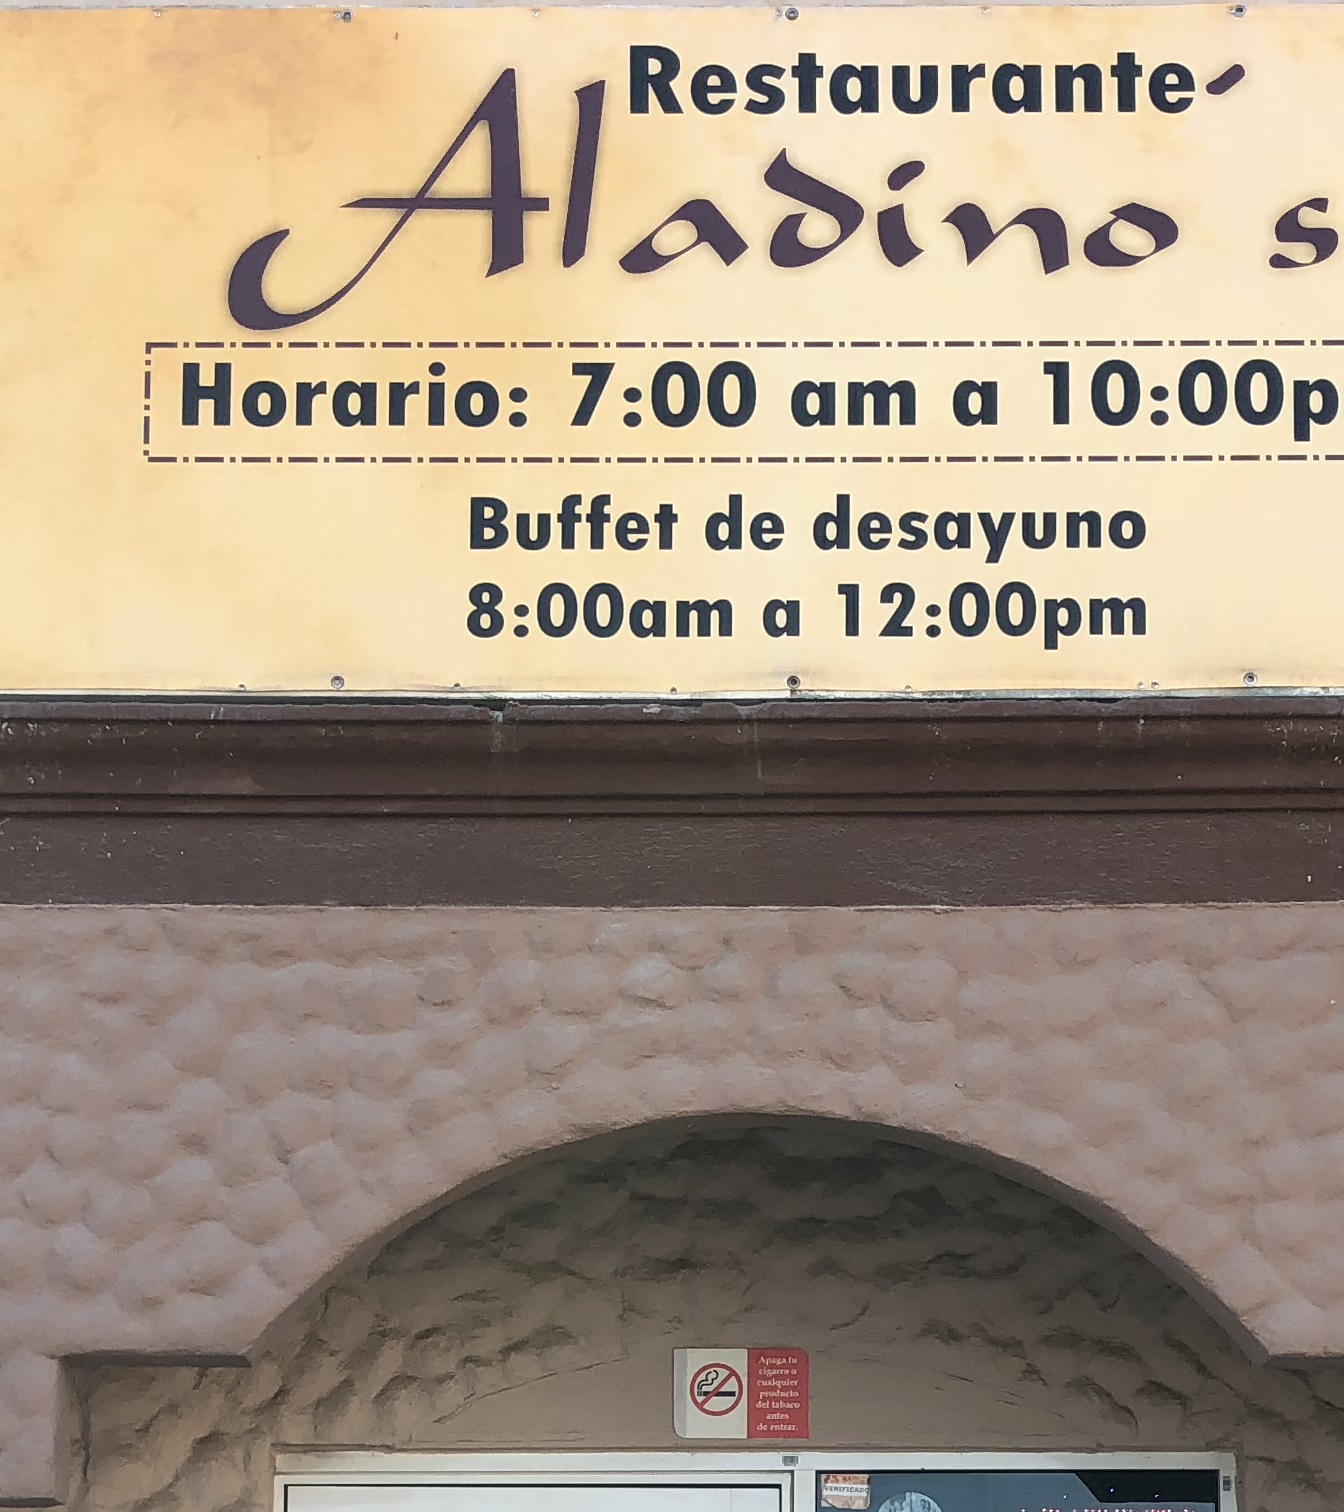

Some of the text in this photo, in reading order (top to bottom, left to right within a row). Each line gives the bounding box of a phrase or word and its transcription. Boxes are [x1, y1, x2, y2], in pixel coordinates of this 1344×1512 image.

[629, 45, 1196, 115] Restaurante
[181, 361, 528, 428] Horario:
[570, 360, 757, 428] 7:00
[790, 380, 916, 427] am
[952, 379, 998, 427] a
[469, 493, 1146, 561] Buffet de desayuno
[466, 581, 1146, 650] 8:00am a 12:00pm
[758, 1356, 799, 1366] Apaga tu
[758, 1367, 790, 1376] cigarro
[757, 1379, 799, 1389] cualquier
[759, 1389, 800, 1400] producto
[756, 1400, 801, 1409] del tabaco
[765, 1412, 790, 1420] antes
[757, 1423, 768, 1431] de
[823, 1485, 870, 1494] VERIFICADO
